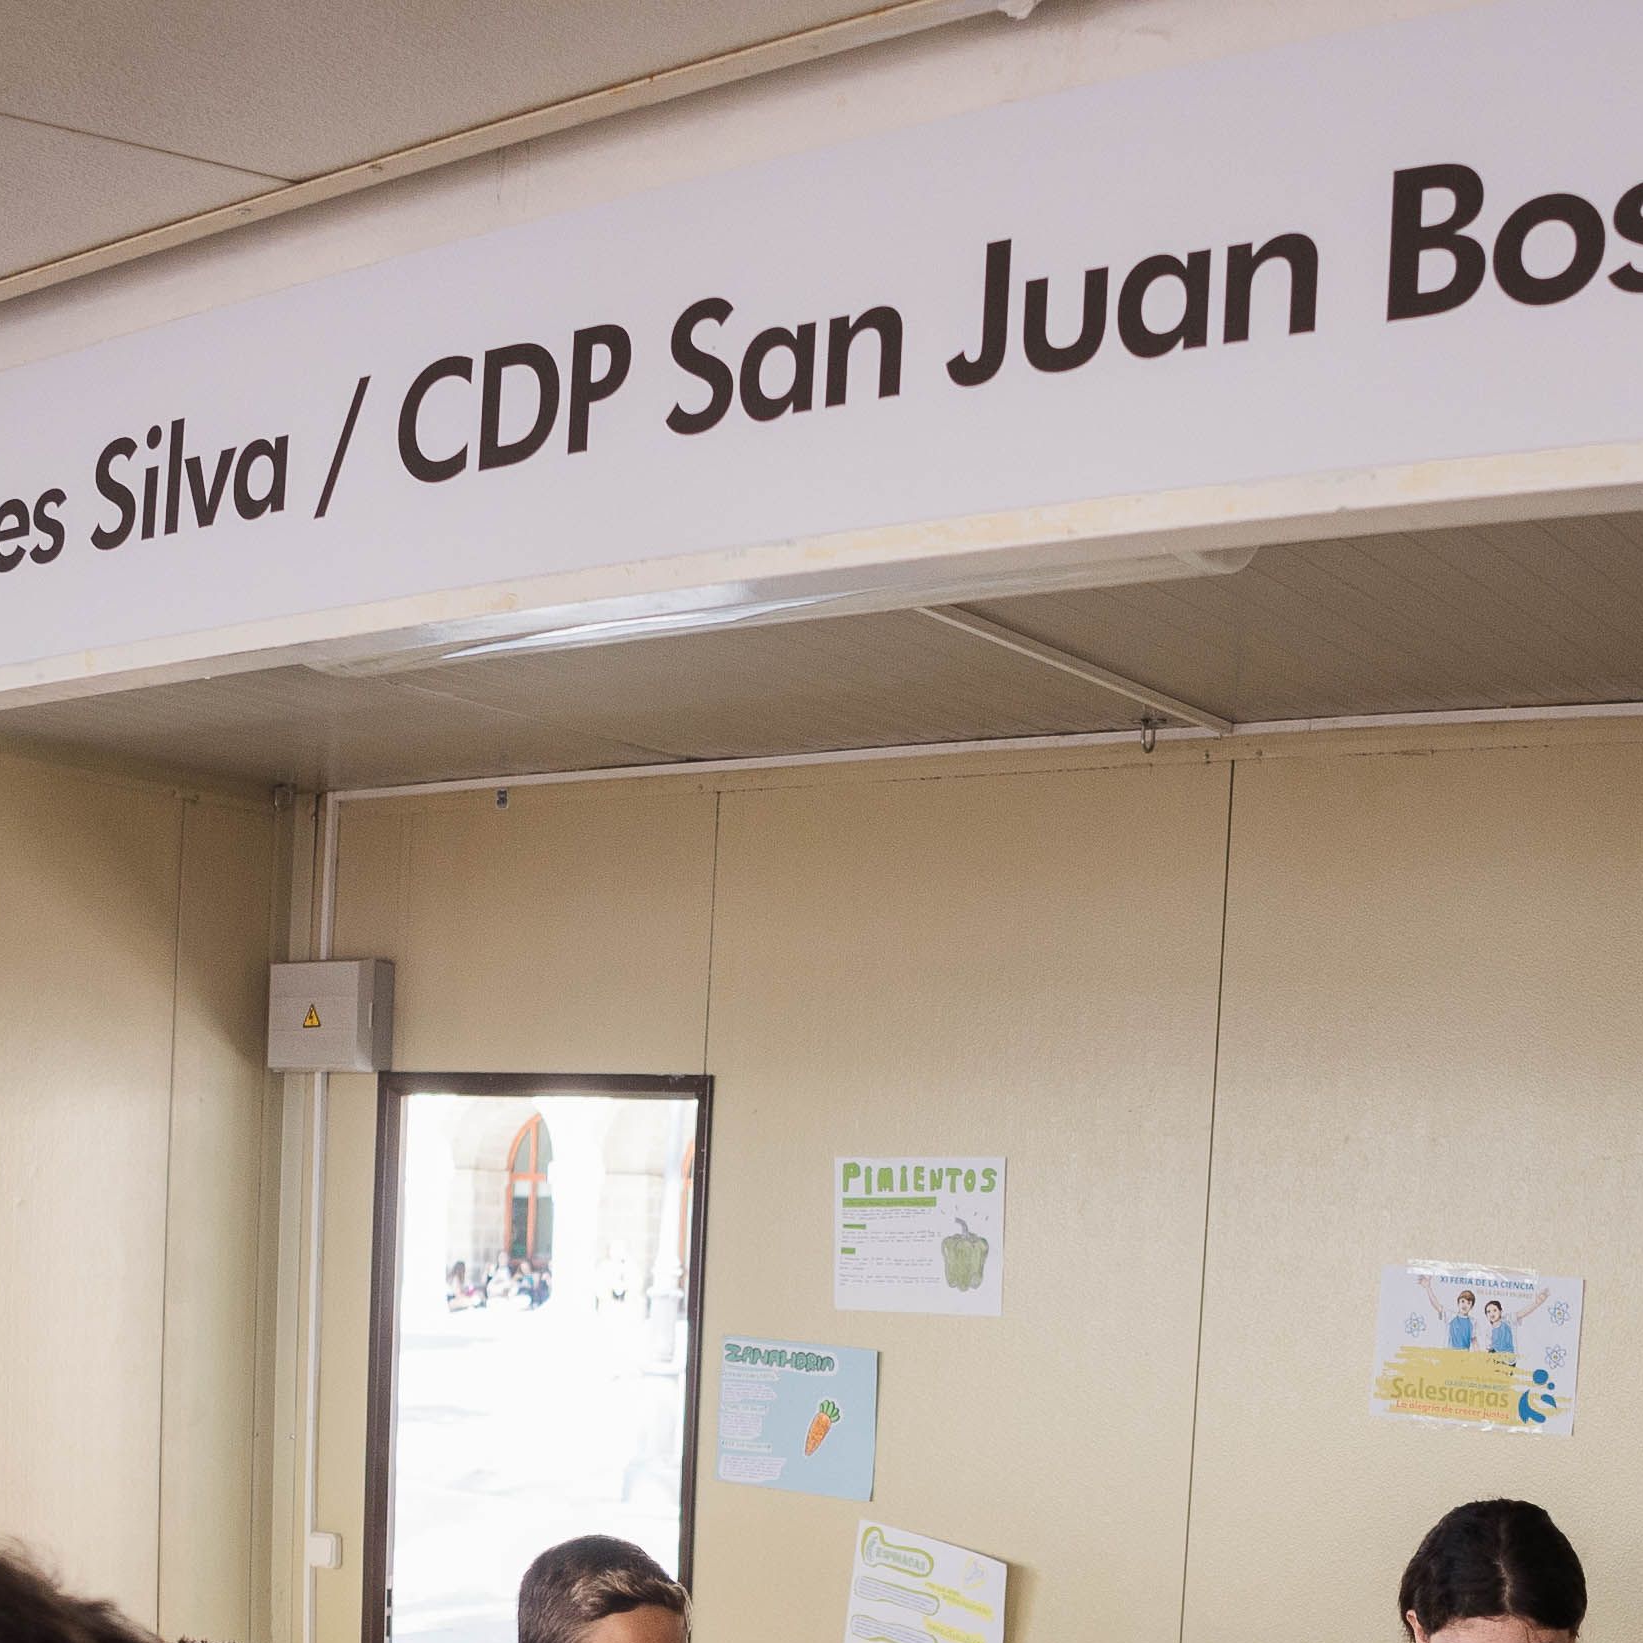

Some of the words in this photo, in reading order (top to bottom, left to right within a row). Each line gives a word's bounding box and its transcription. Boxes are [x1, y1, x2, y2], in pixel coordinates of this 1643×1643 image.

[89, 417, 290, 551] Silva
[313, 375, 372, 520] /
[397, 323, 632, 484] CDP
[665, 296, 904, 436] San
[945, 232, 1319, 388] Juan
[842, 1161, 998, 1195] PIMIENTOS
[1449, 1276, 1473, 1286] FERIA
[1475, 1278, 1486, 1287] DE
[1488, 1279, 1499, 1288] LA
[1500, 1281, 1535, 1291] CIENCIA
[1390, 1375, 1509, 1409] Salesianas
